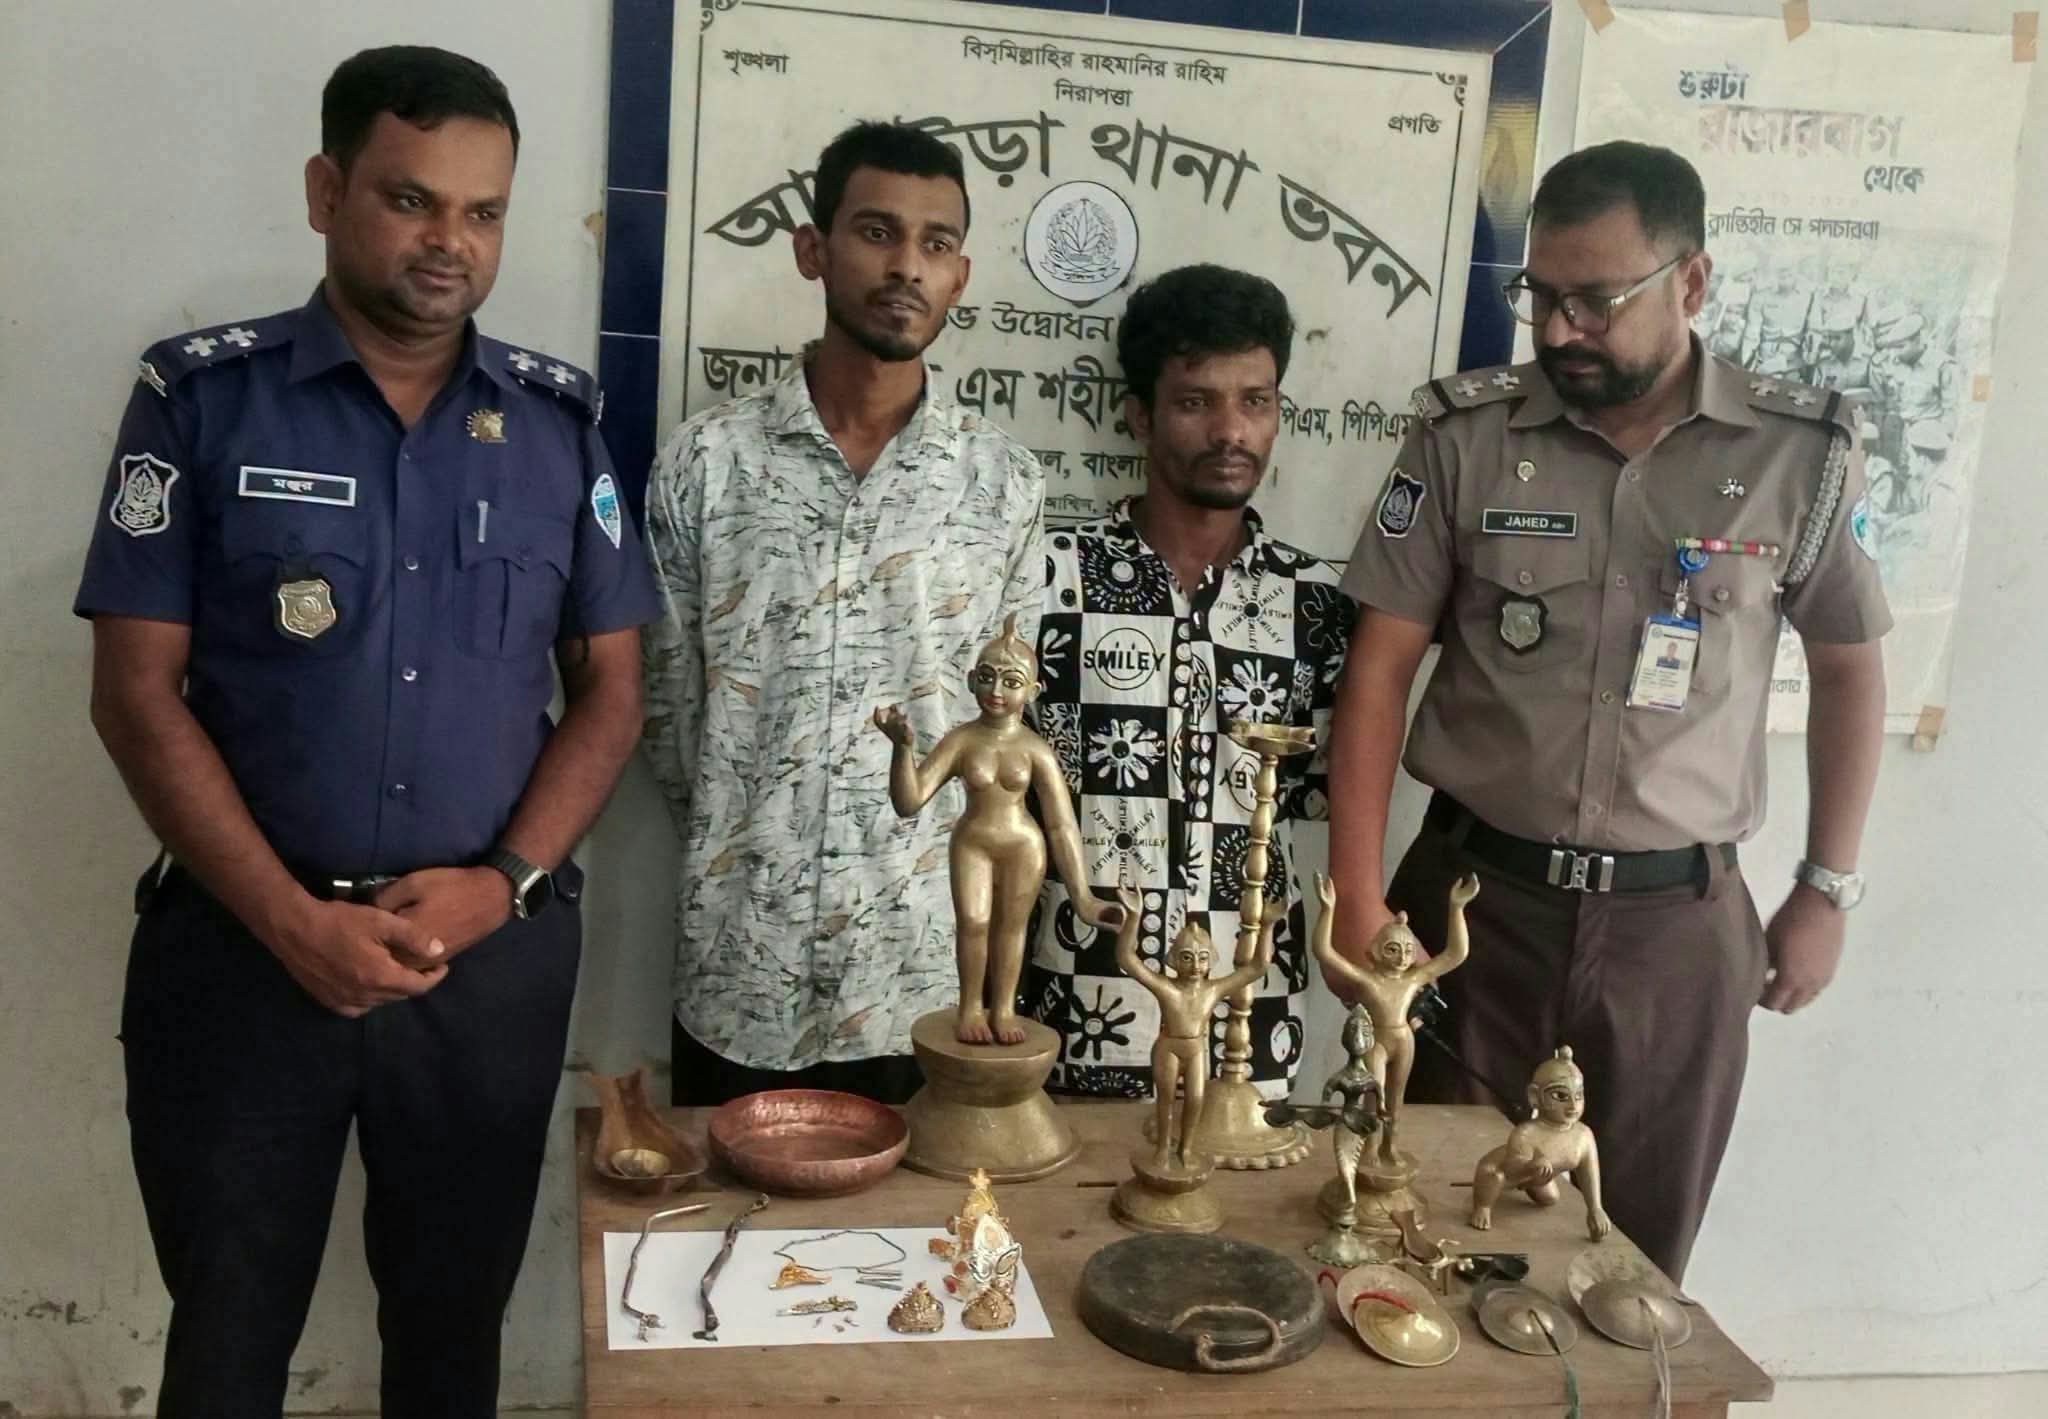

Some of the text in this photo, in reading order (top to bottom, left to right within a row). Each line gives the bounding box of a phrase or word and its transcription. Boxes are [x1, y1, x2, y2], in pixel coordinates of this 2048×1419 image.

[1081, 53, 1168, 78] রাহমানির
[1174, 59, 1228, 84] রাহিম
[1054, 79, 1133, 107] নিরাপত্তা
[1388, 113, 1442, 135] প্রগতি
[1864, 164, 1926, 193] থেকে
[1090, 117, 1260, 212] থানা
[1278, 173, 1432, 319] ভবন
[1783, 217, 1803, 236] সে
[991, 301, 1115, 342] উদ্বোধন
[698, 345, 794, 397] জনা
[1504, 515, 1549, 529] JAHED
[1084, 649, 1167, 672] SMILEY
